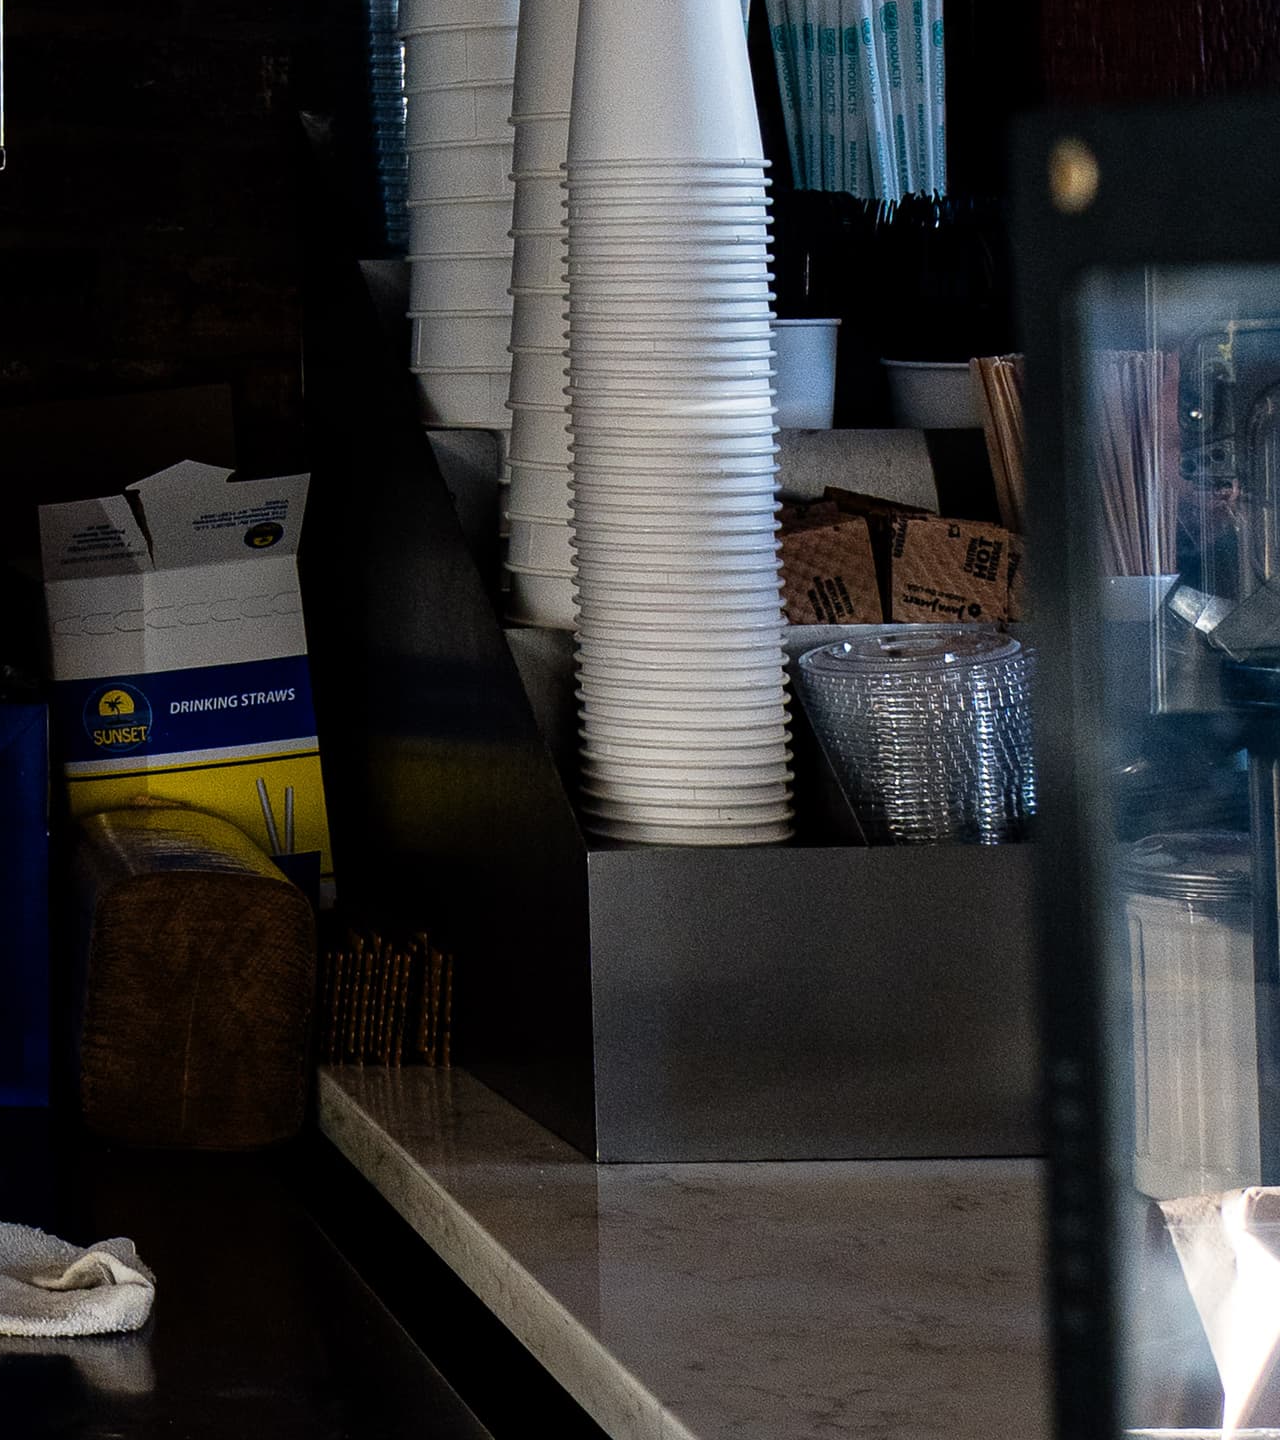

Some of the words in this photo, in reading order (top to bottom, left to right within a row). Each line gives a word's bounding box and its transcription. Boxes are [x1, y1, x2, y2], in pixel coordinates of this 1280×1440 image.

[889, 30, 901, 89] PRODUCTS
[914, 27, 924, 84] PRODUCTS
[826, 57, 836, 117] PRODUCTS
[847, 56, 857, 116] PRODUCTS
[973, 536, 993, 579] HOT
[987, 541, 1002, 582] BEVERAGE
[169, 695, 239, 715] DRINKING
[241, 688, 297, 707] STRAWS
[92, 725, 149, 746] SUNSET
